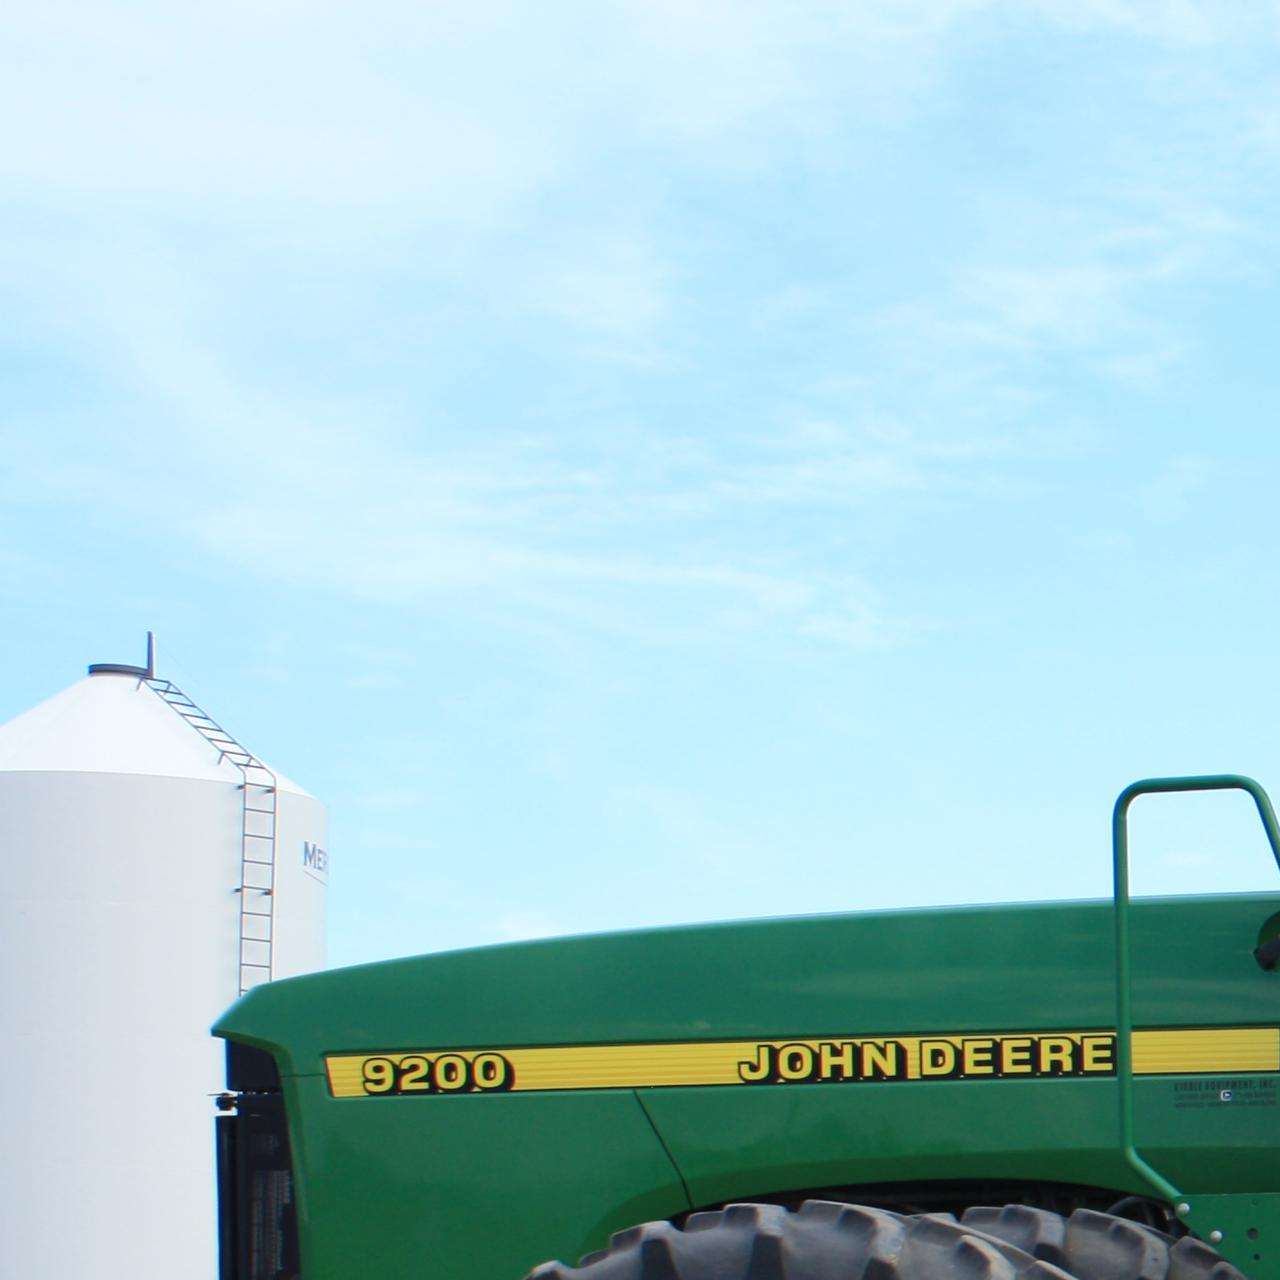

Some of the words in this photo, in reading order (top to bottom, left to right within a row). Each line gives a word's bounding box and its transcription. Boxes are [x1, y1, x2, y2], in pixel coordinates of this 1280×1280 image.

[362, 1052, 516, 1095] 9200
[737, 1040, 909, 1085] JOHN
[920, 1034, 1117, 1080] DEERE
